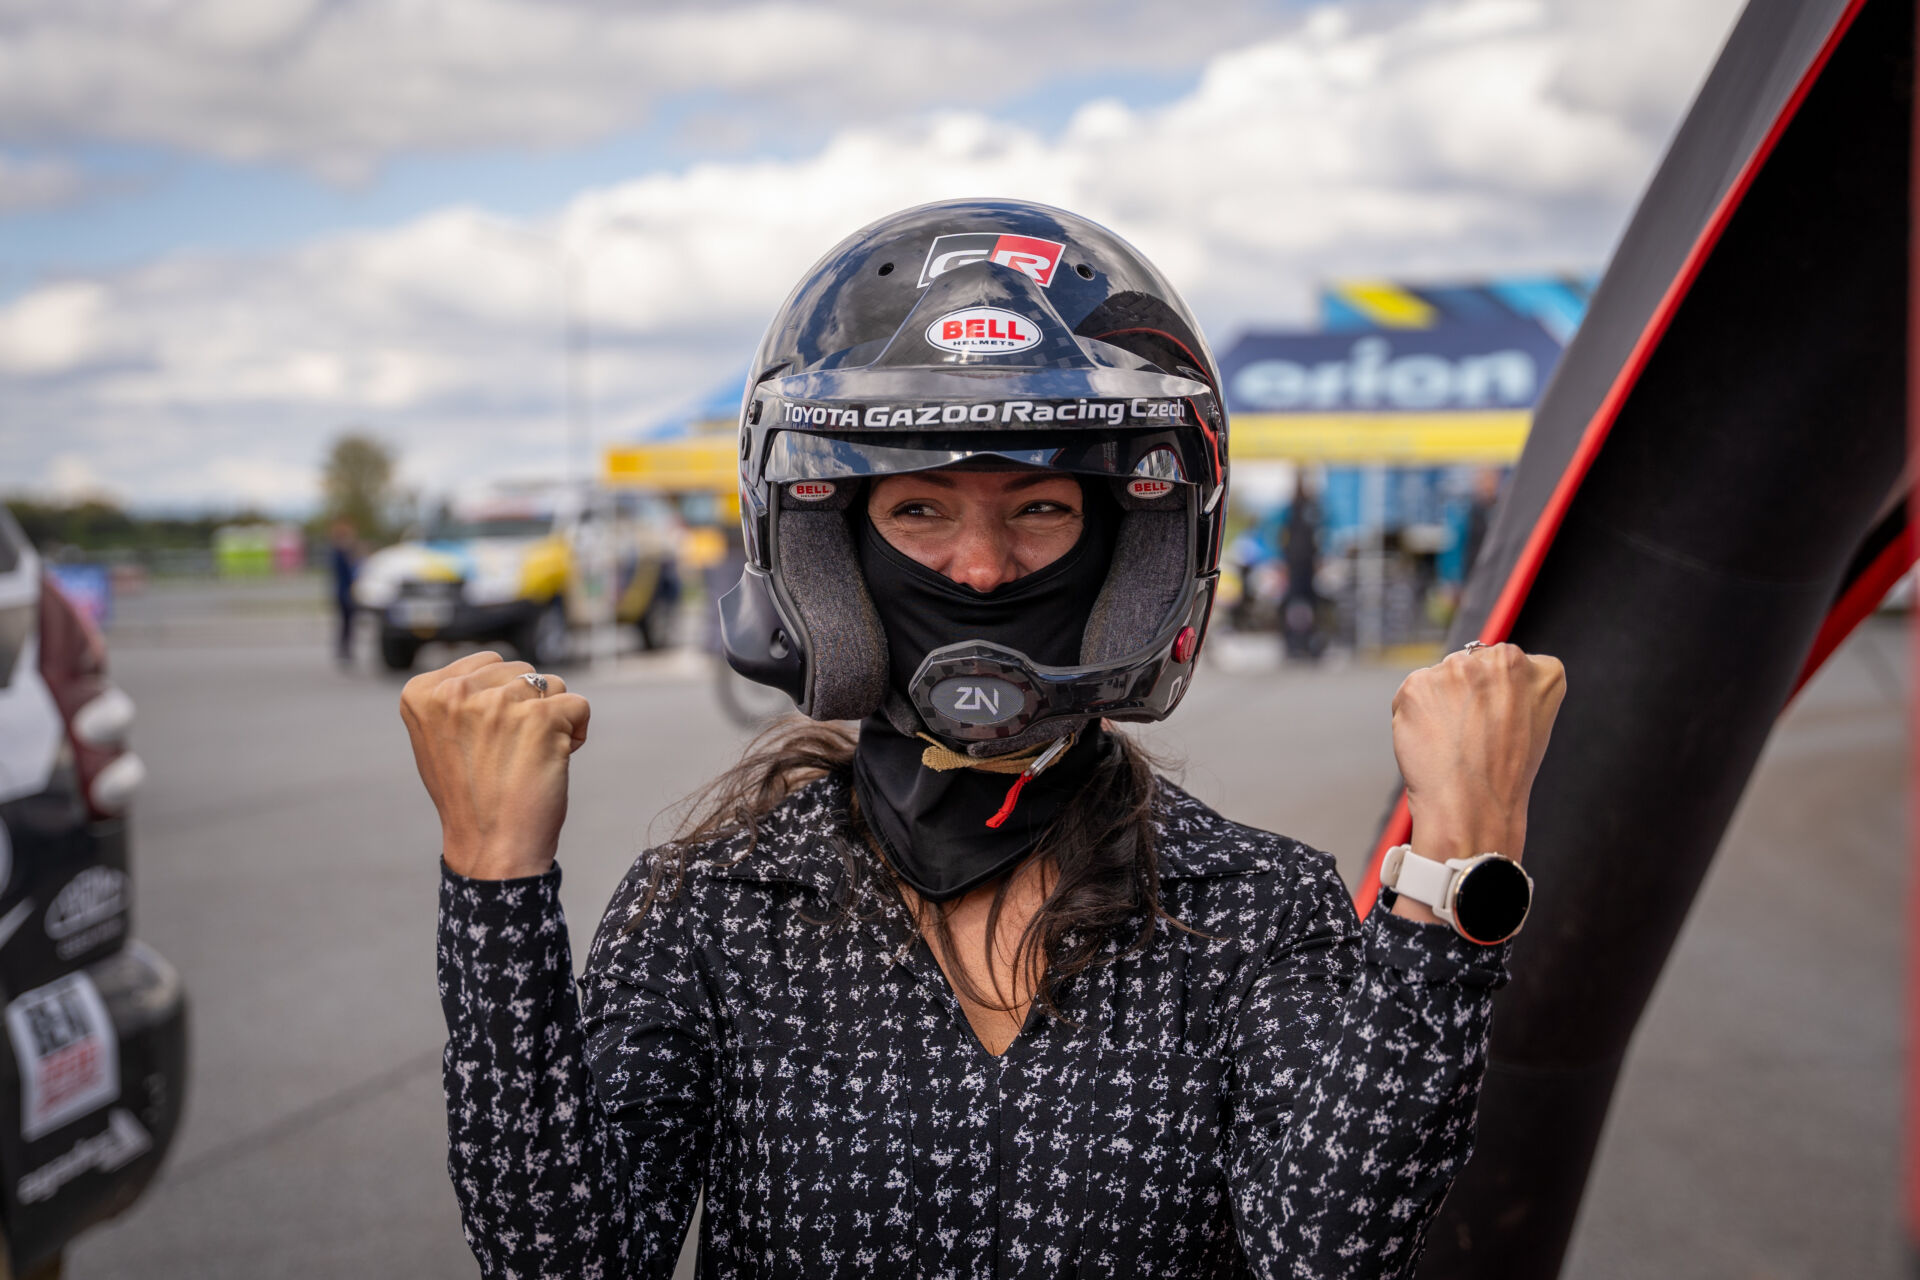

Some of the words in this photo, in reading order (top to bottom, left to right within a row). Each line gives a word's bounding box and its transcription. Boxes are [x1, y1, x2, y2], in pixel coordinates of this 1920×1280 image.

[942, 318, 1026, 342] BELL
[784, 402, 859, 428] TOYOTA
[864, 404, 996, 428] GAZOO
[1001, 399, 1125, 426] Racing
[1130, 398, 1186, 418] Czech
[796, 485, 830, 494] BELL
[1134, 482, 1168, 492] BELL
[954, 686, 1000, 716] ZN
